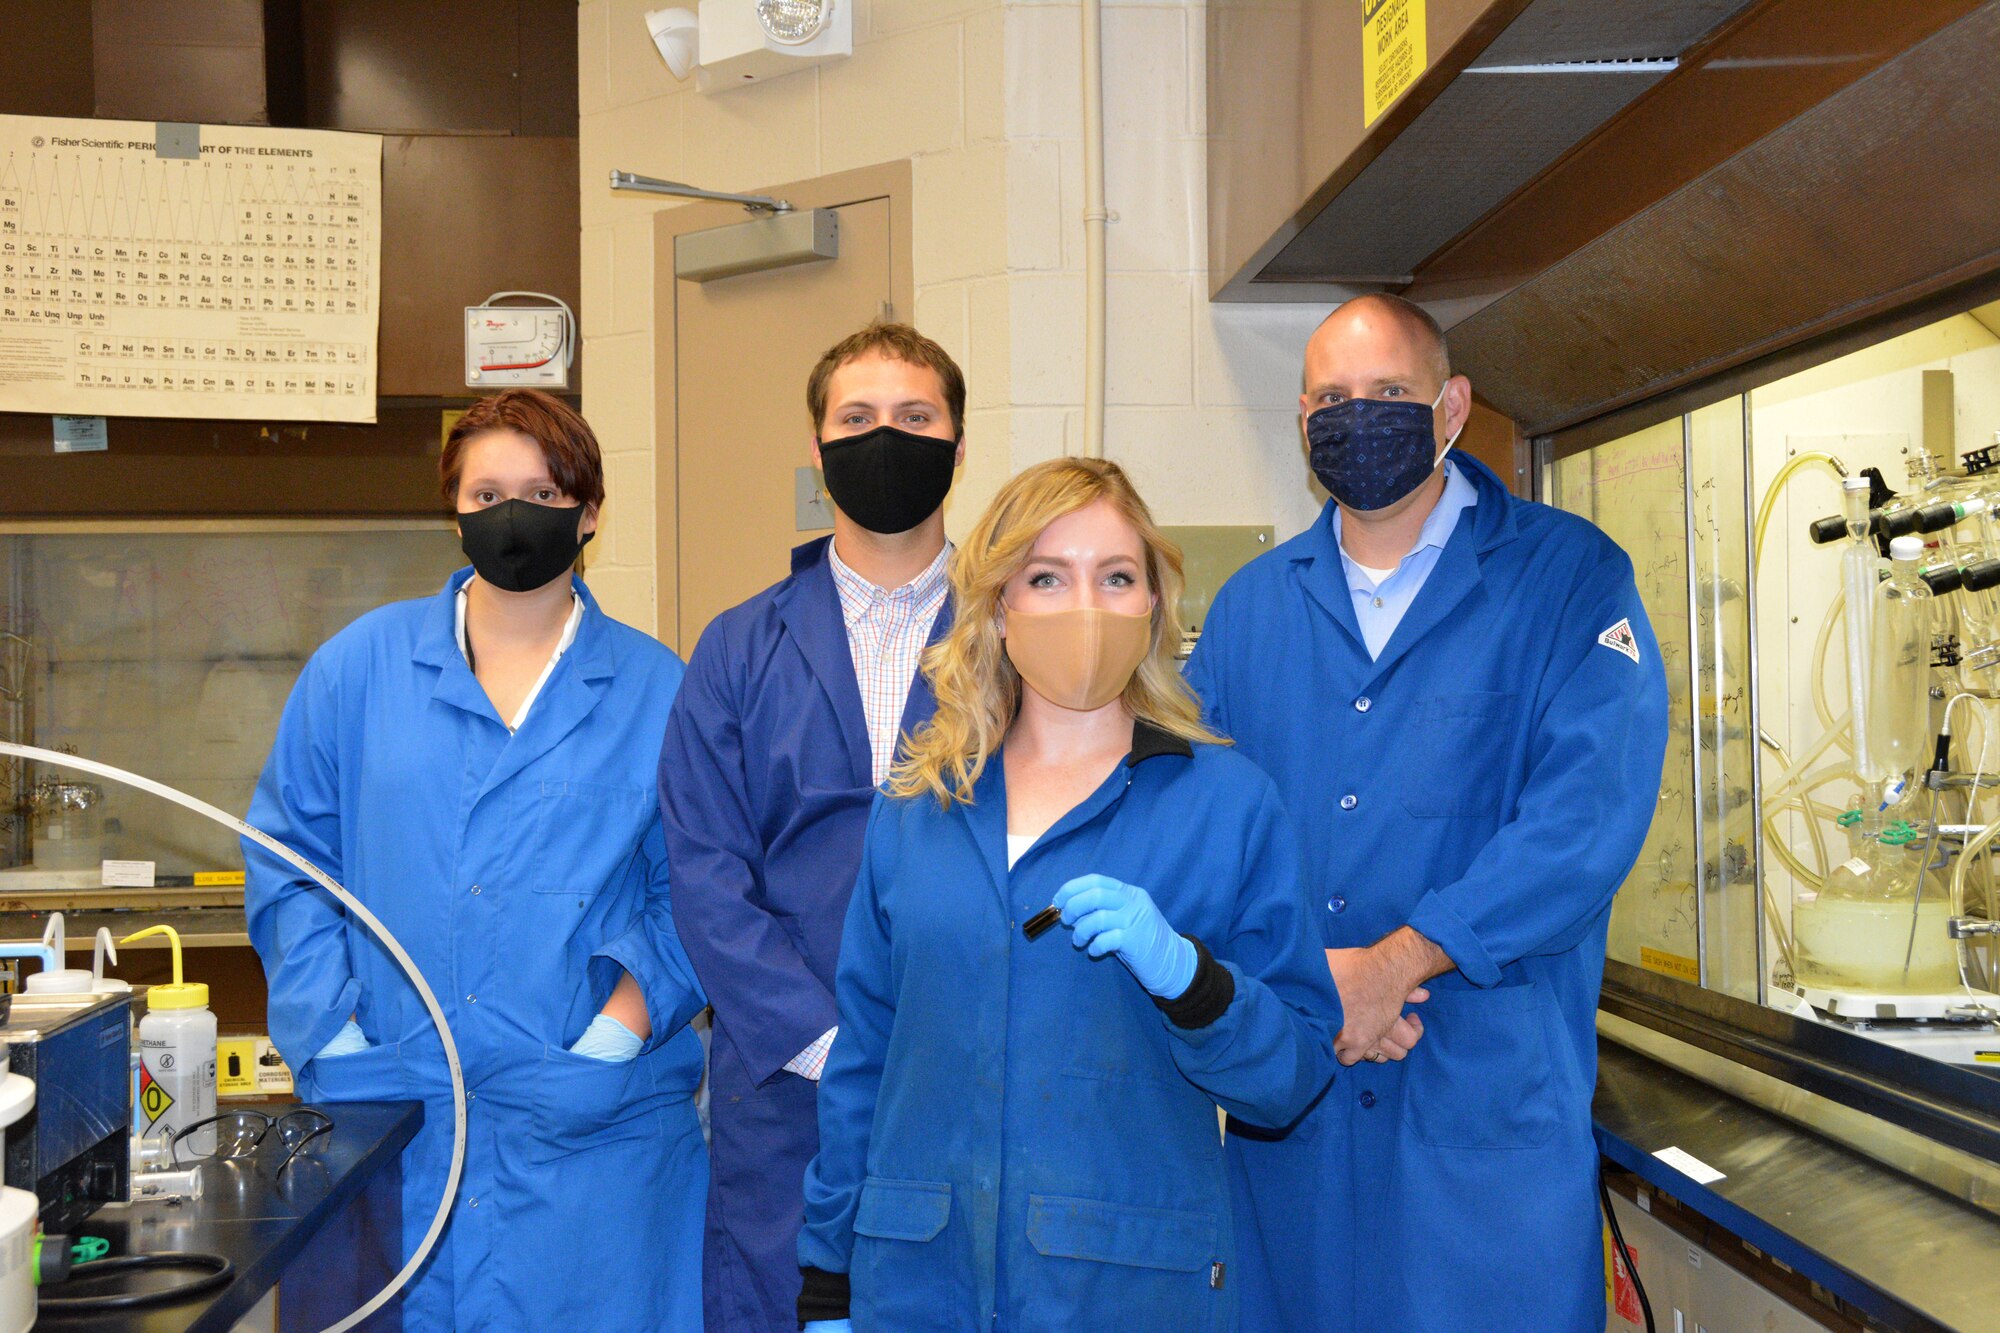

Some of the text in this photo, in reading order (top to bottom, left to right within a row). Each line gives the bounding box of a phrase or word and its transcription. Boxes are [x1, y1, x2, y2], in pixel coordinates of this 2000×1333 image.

[1378, 26, 1393, 56] WORK
[1394, 8, 1409, 39] AREA
[234, 146, 255, 155] THE
[258, 148, 313, 158] ELEMENTS
[1605, 638, 1629, 652] Bulwark
[146, 1086, 161, 1112] 0
